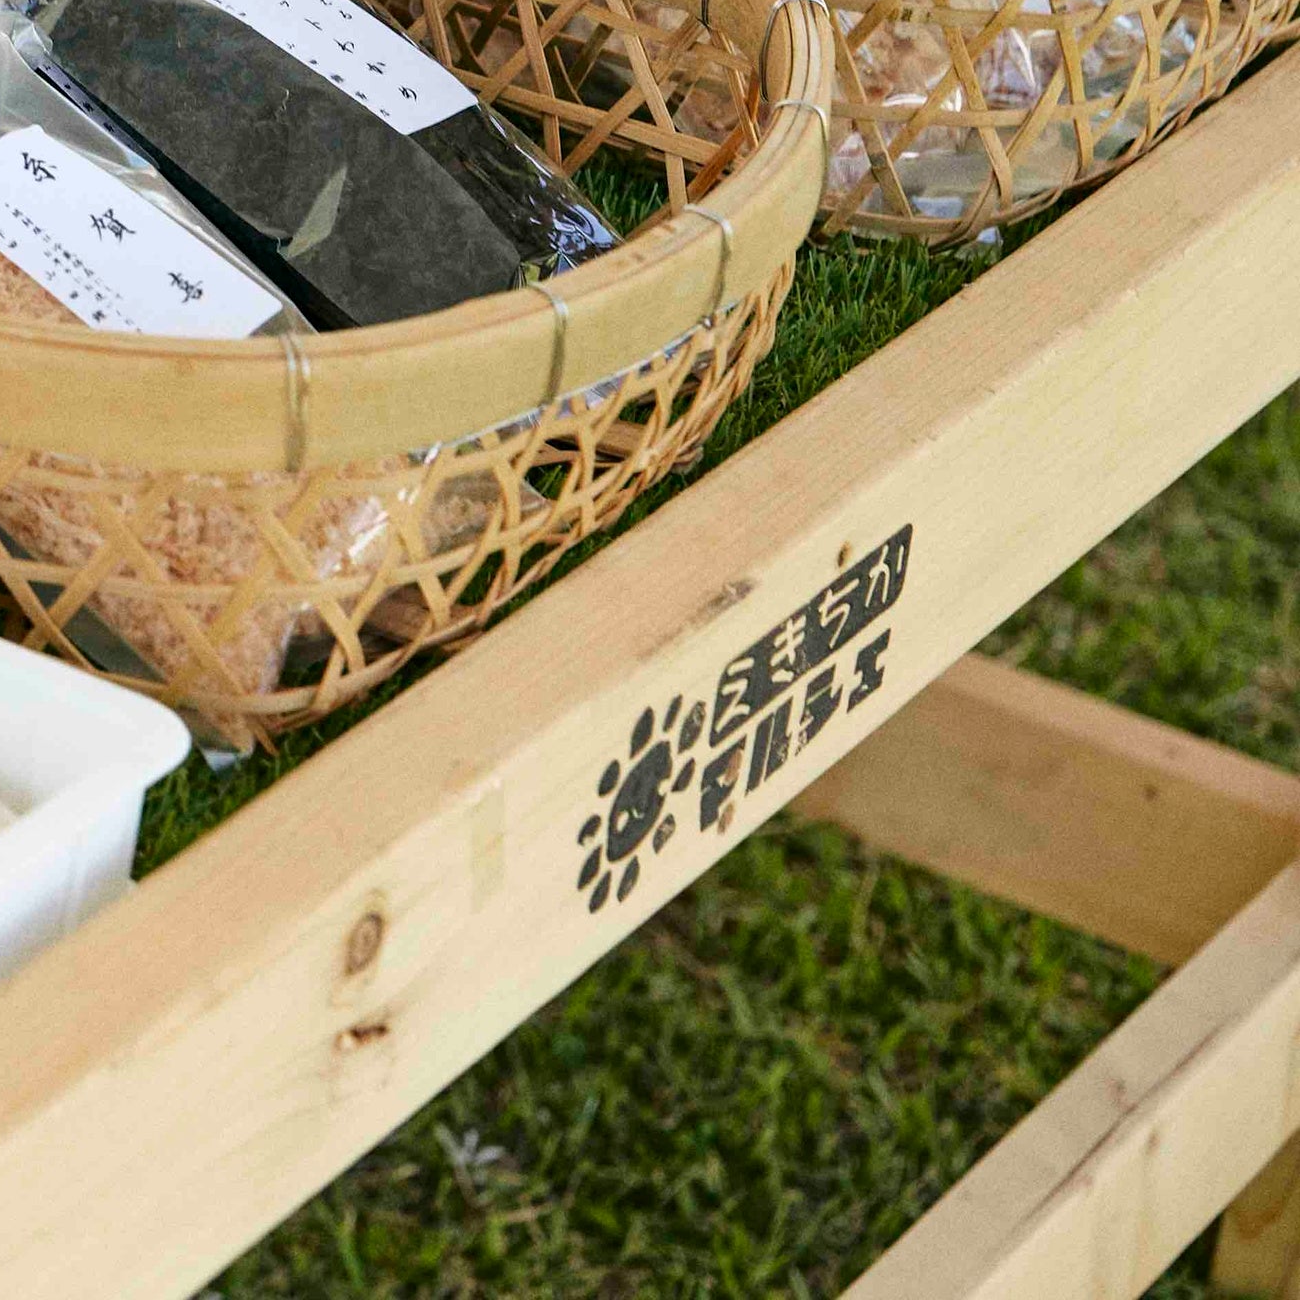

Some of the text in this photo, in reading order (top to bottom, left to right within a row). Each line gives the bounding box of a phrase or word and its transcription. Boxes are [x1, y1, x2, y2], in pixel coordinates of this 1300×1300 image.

[21, 151, 204, 303] 糸賀喜
[700, 628, 891, 834] マルシェ
